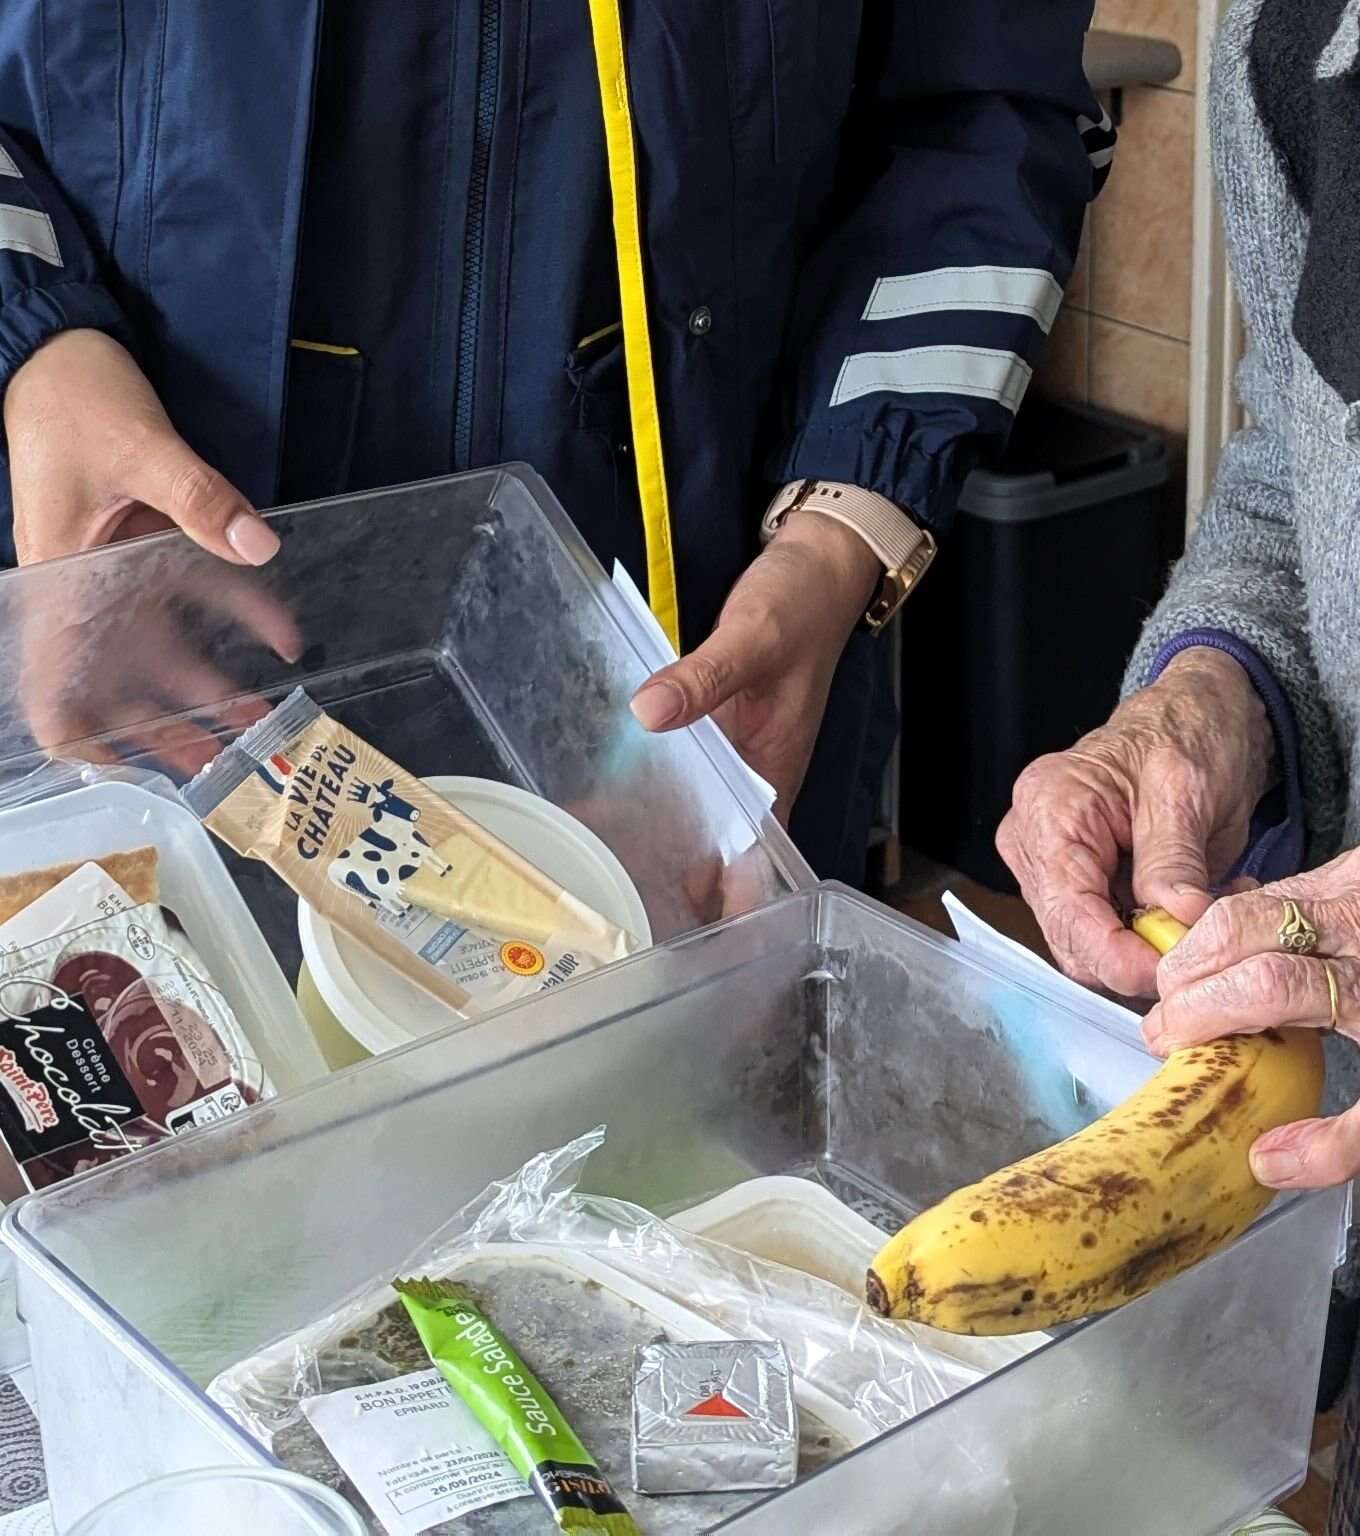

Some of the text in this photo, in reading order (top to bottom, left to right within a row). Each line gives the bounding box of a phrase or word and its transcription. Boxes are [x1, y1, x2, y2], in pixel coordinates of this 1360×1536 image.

[285, 744, 328, 831] LA VIE DE
[297, 744, 356, 859] CHATEAU
[557, 952, 580, 978] AOP
[66, 1038, 102, 1093] Dessert
[82, 1037, 111, 1084] Crème
[455, 1311, 557, 1437] Sauce Salade
[360, 1384, 453, 1412] BON APPETI
[394, 1401, 449, 1417] EPINARD
[446, 1451, 501, 1468] 23/09/2024
[406, 1473, 463, 1493] consommer
[430, 1471, 503, 1496] 26/09/2024
